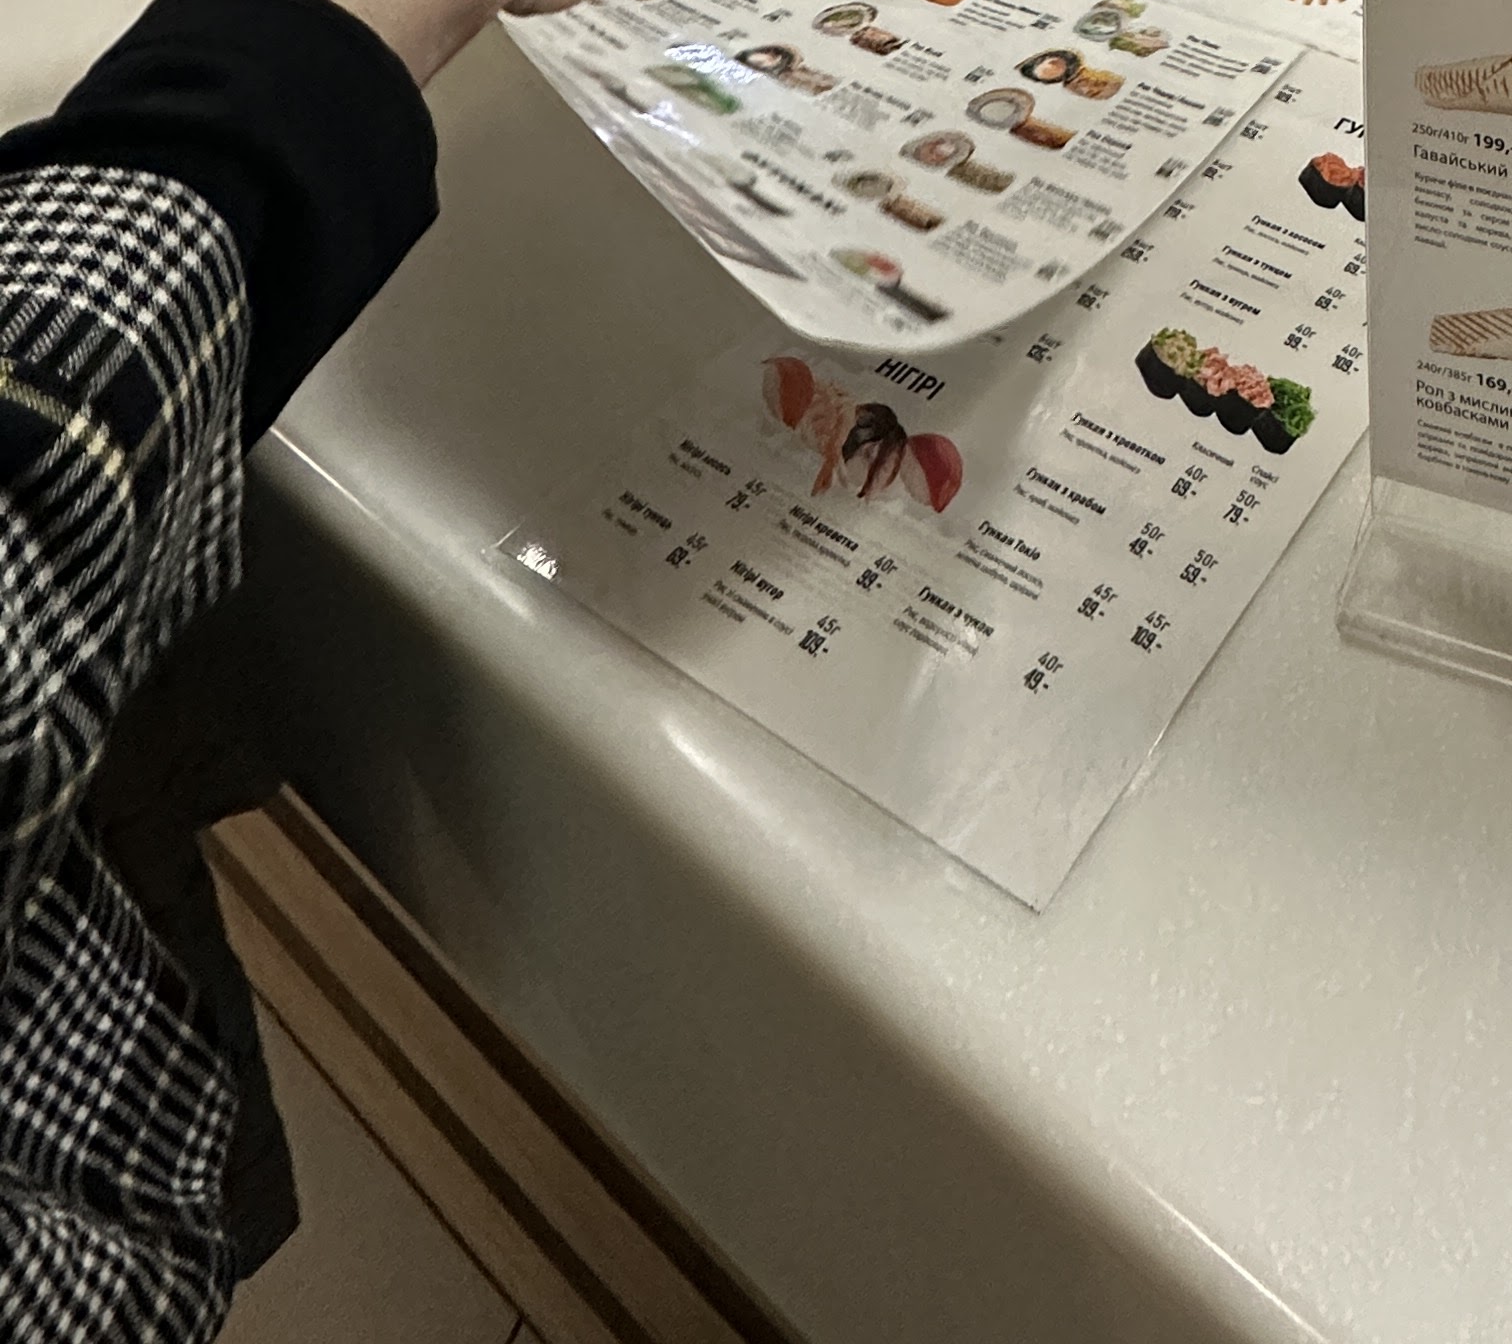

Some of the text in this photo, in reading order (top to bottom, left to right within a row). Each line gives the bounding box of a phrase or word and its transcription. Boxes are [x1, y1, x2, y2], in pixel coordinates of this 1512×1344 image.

[875, 357, 946, 400] НІГІРІ
[1415, 379, 1444, 399] Рол
[1415, 396, 1510, 432] ковбасками
[1236, 490, 1261, 509] 50г
